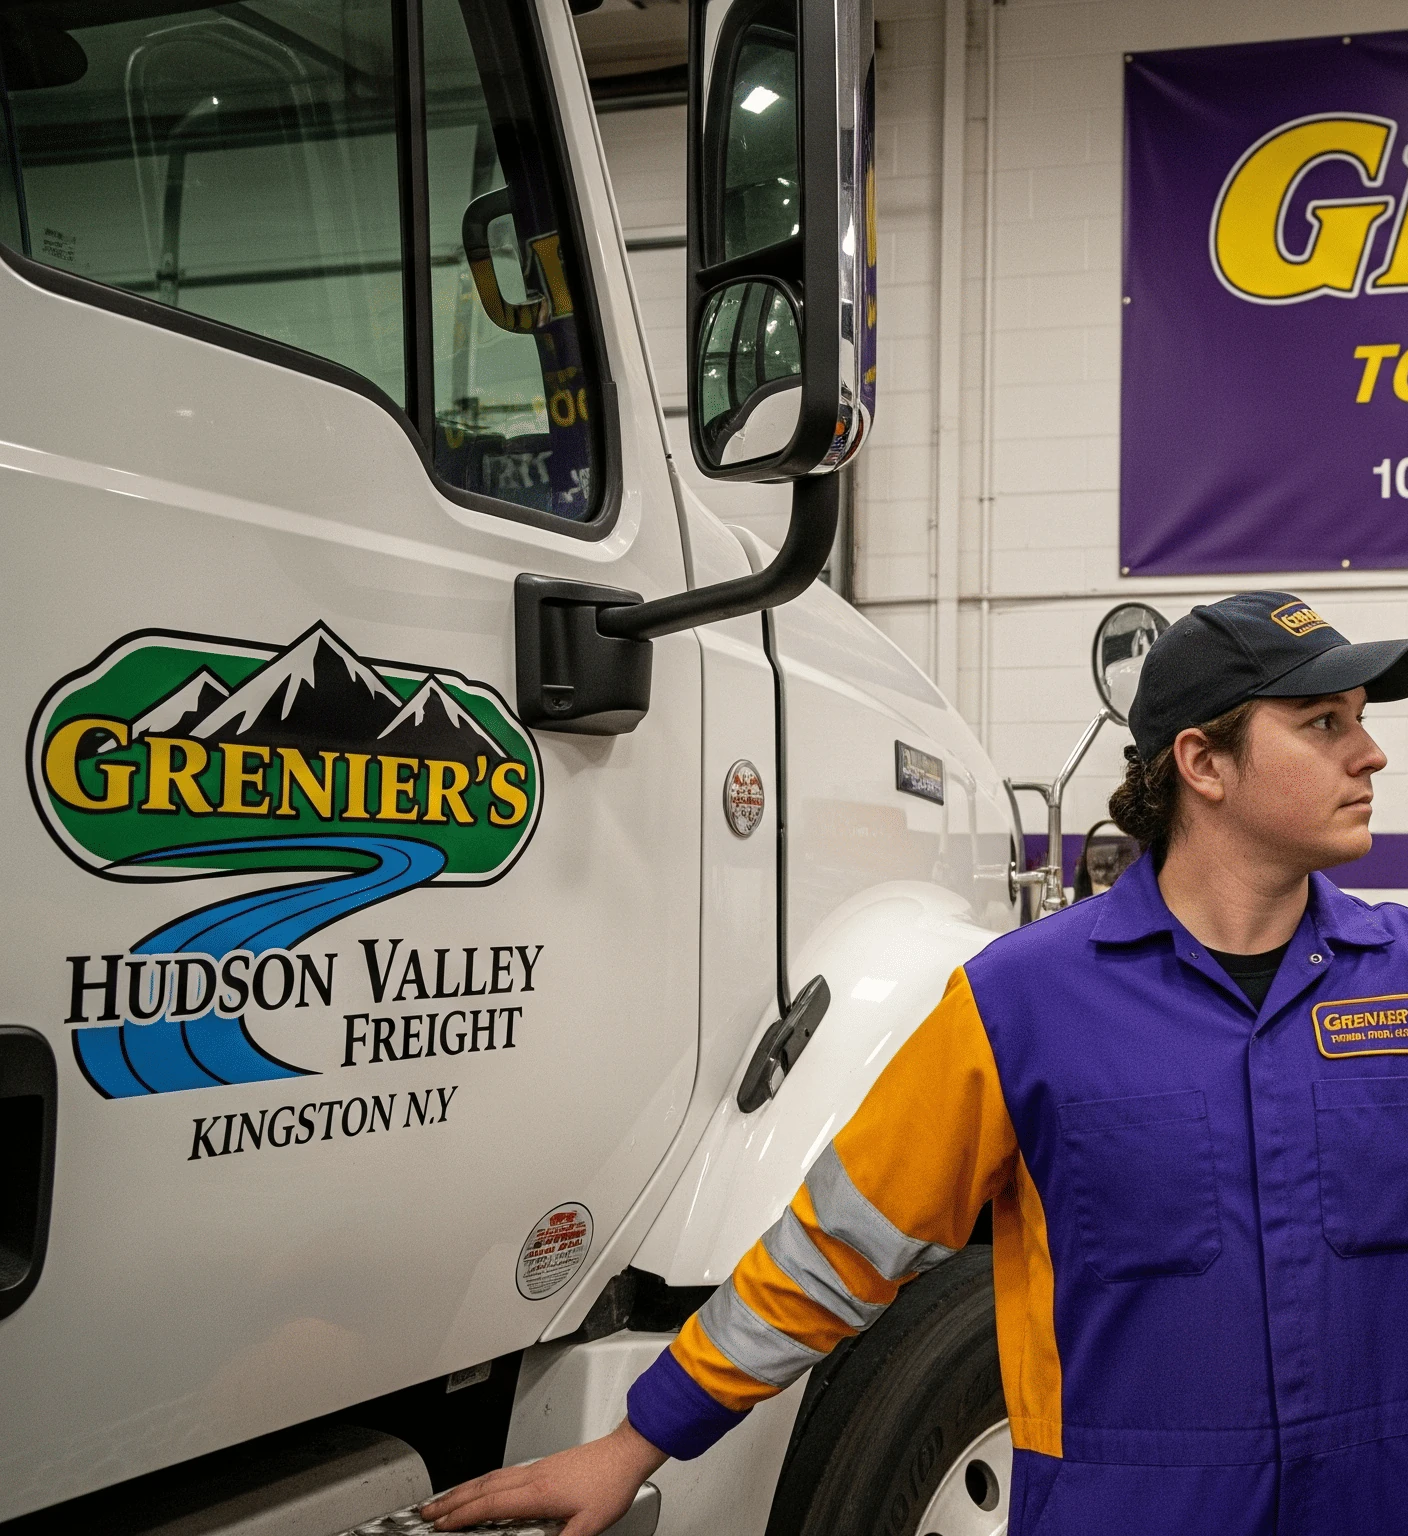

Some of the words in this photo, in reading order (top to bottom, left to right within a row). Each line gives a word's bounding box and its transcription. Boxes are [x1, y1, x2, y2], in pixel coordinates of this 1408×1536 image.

[44, 717, 529, 828] GRENIER'S
[63, 952, 338, 1025] HUDSON
[358, 938, 544, 1004] VALLEY
[340, 1007, 523, 1068] FREIGHT
[187, 1093, 397, 1161] KINGSTON
